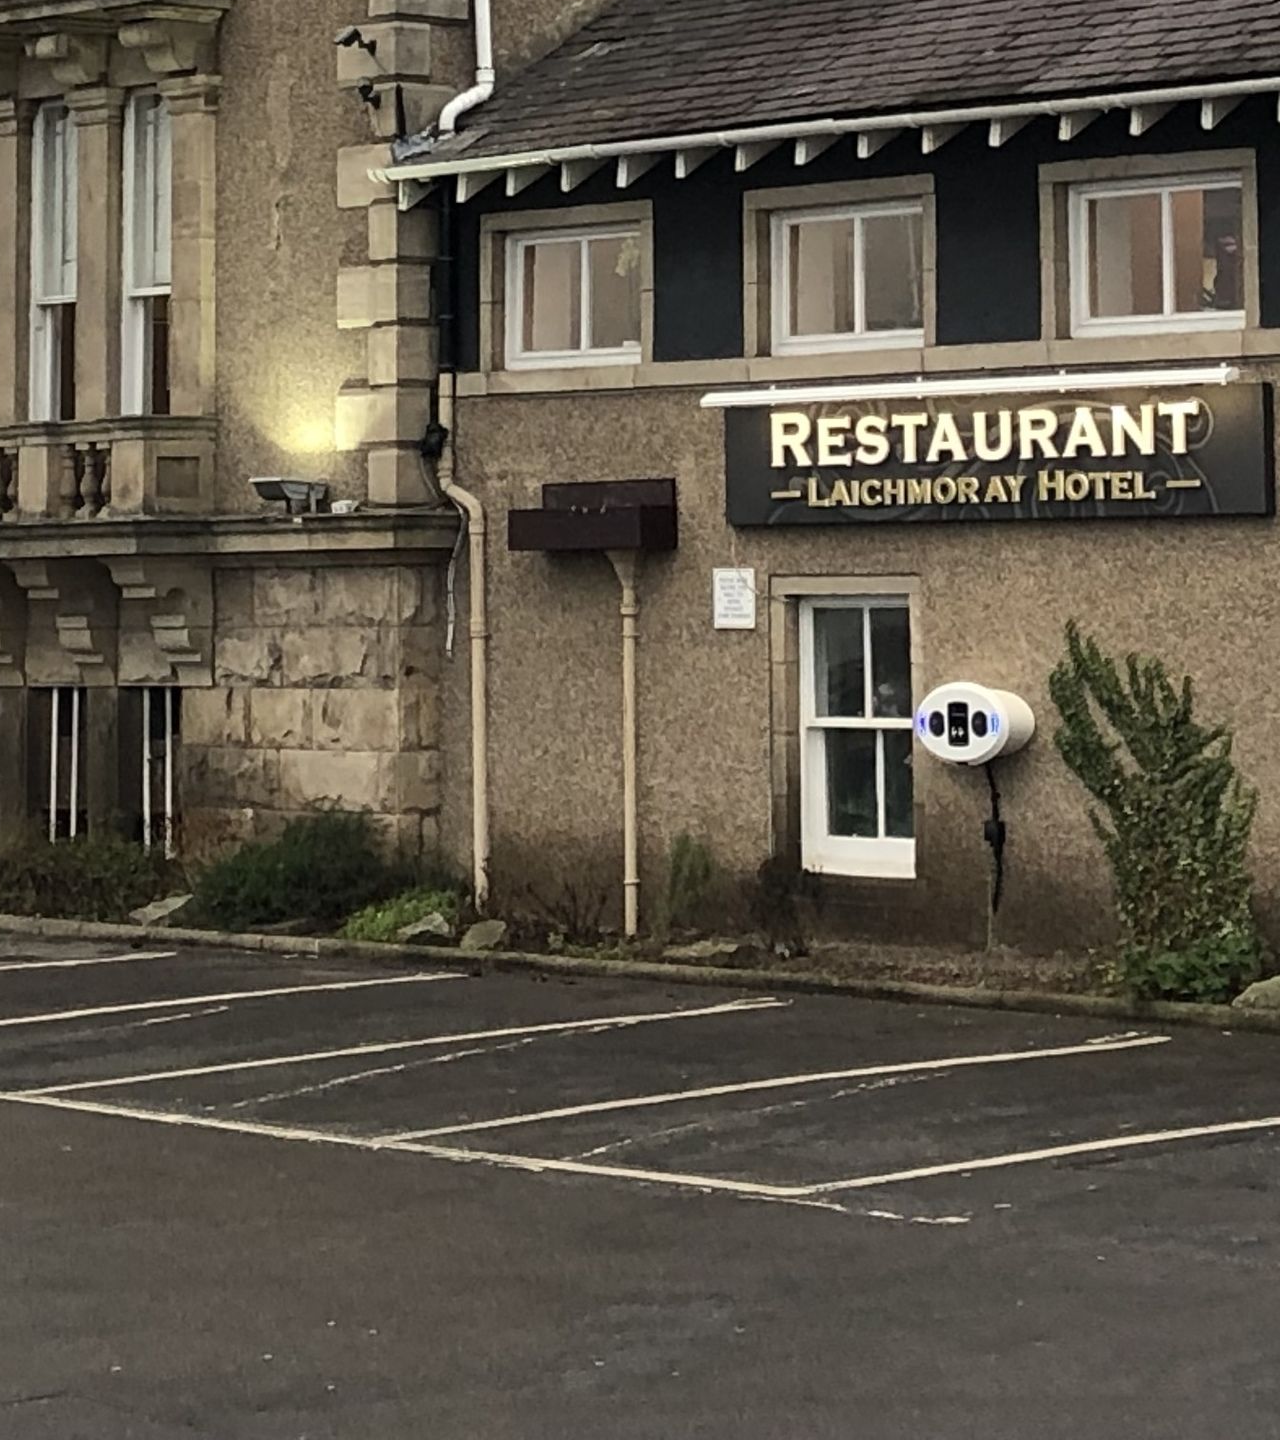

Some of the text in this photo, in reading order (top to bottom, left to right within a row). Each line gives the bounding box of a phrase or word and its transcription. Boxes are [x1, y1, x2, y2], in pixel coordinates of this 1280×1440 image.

[770, 401, 1199, 468] RESTAURANT
[808, 470, 1156, 507] LAICHMORAY HOTEL
